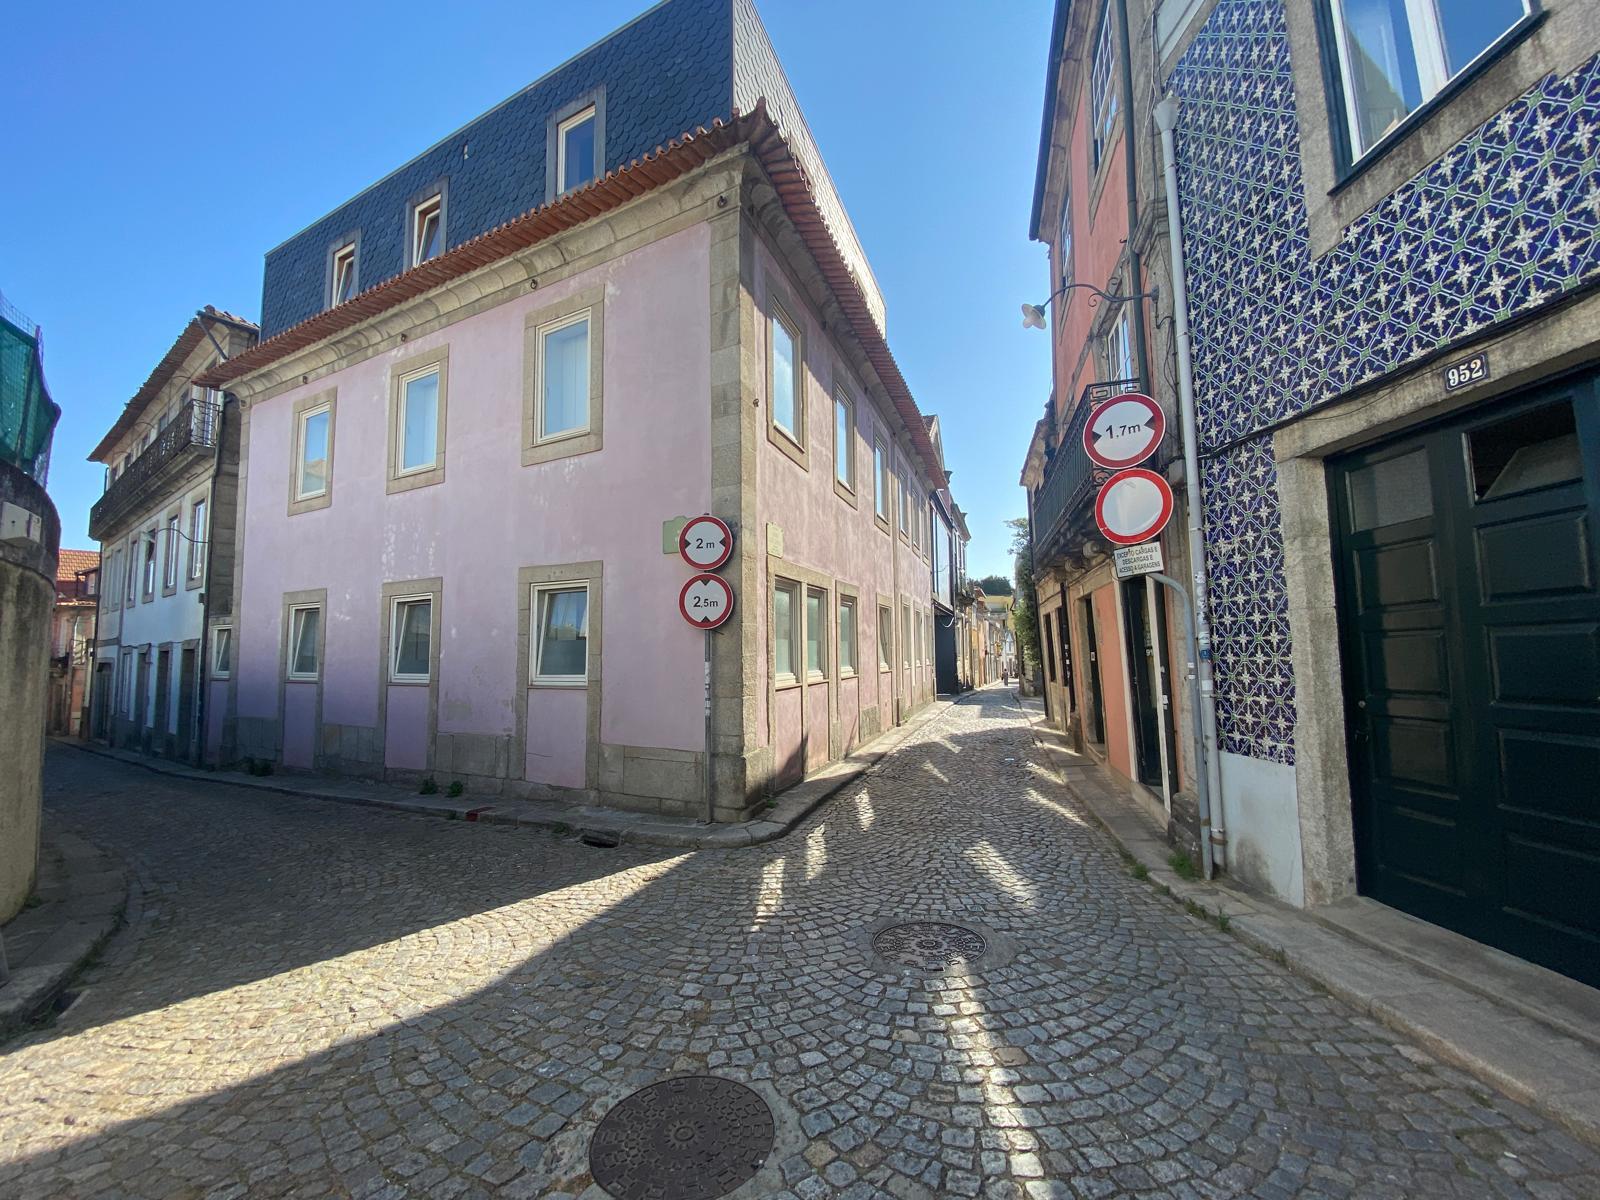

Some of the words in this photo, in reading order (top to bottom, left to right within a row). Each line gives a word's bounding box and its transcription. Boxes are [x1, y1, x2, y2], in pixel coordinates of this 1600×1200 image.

[1448, 359, 1483, 386] 952
[1105, 424, 1141, 439] 1.7m
[696, 538, 704, 549] 2
